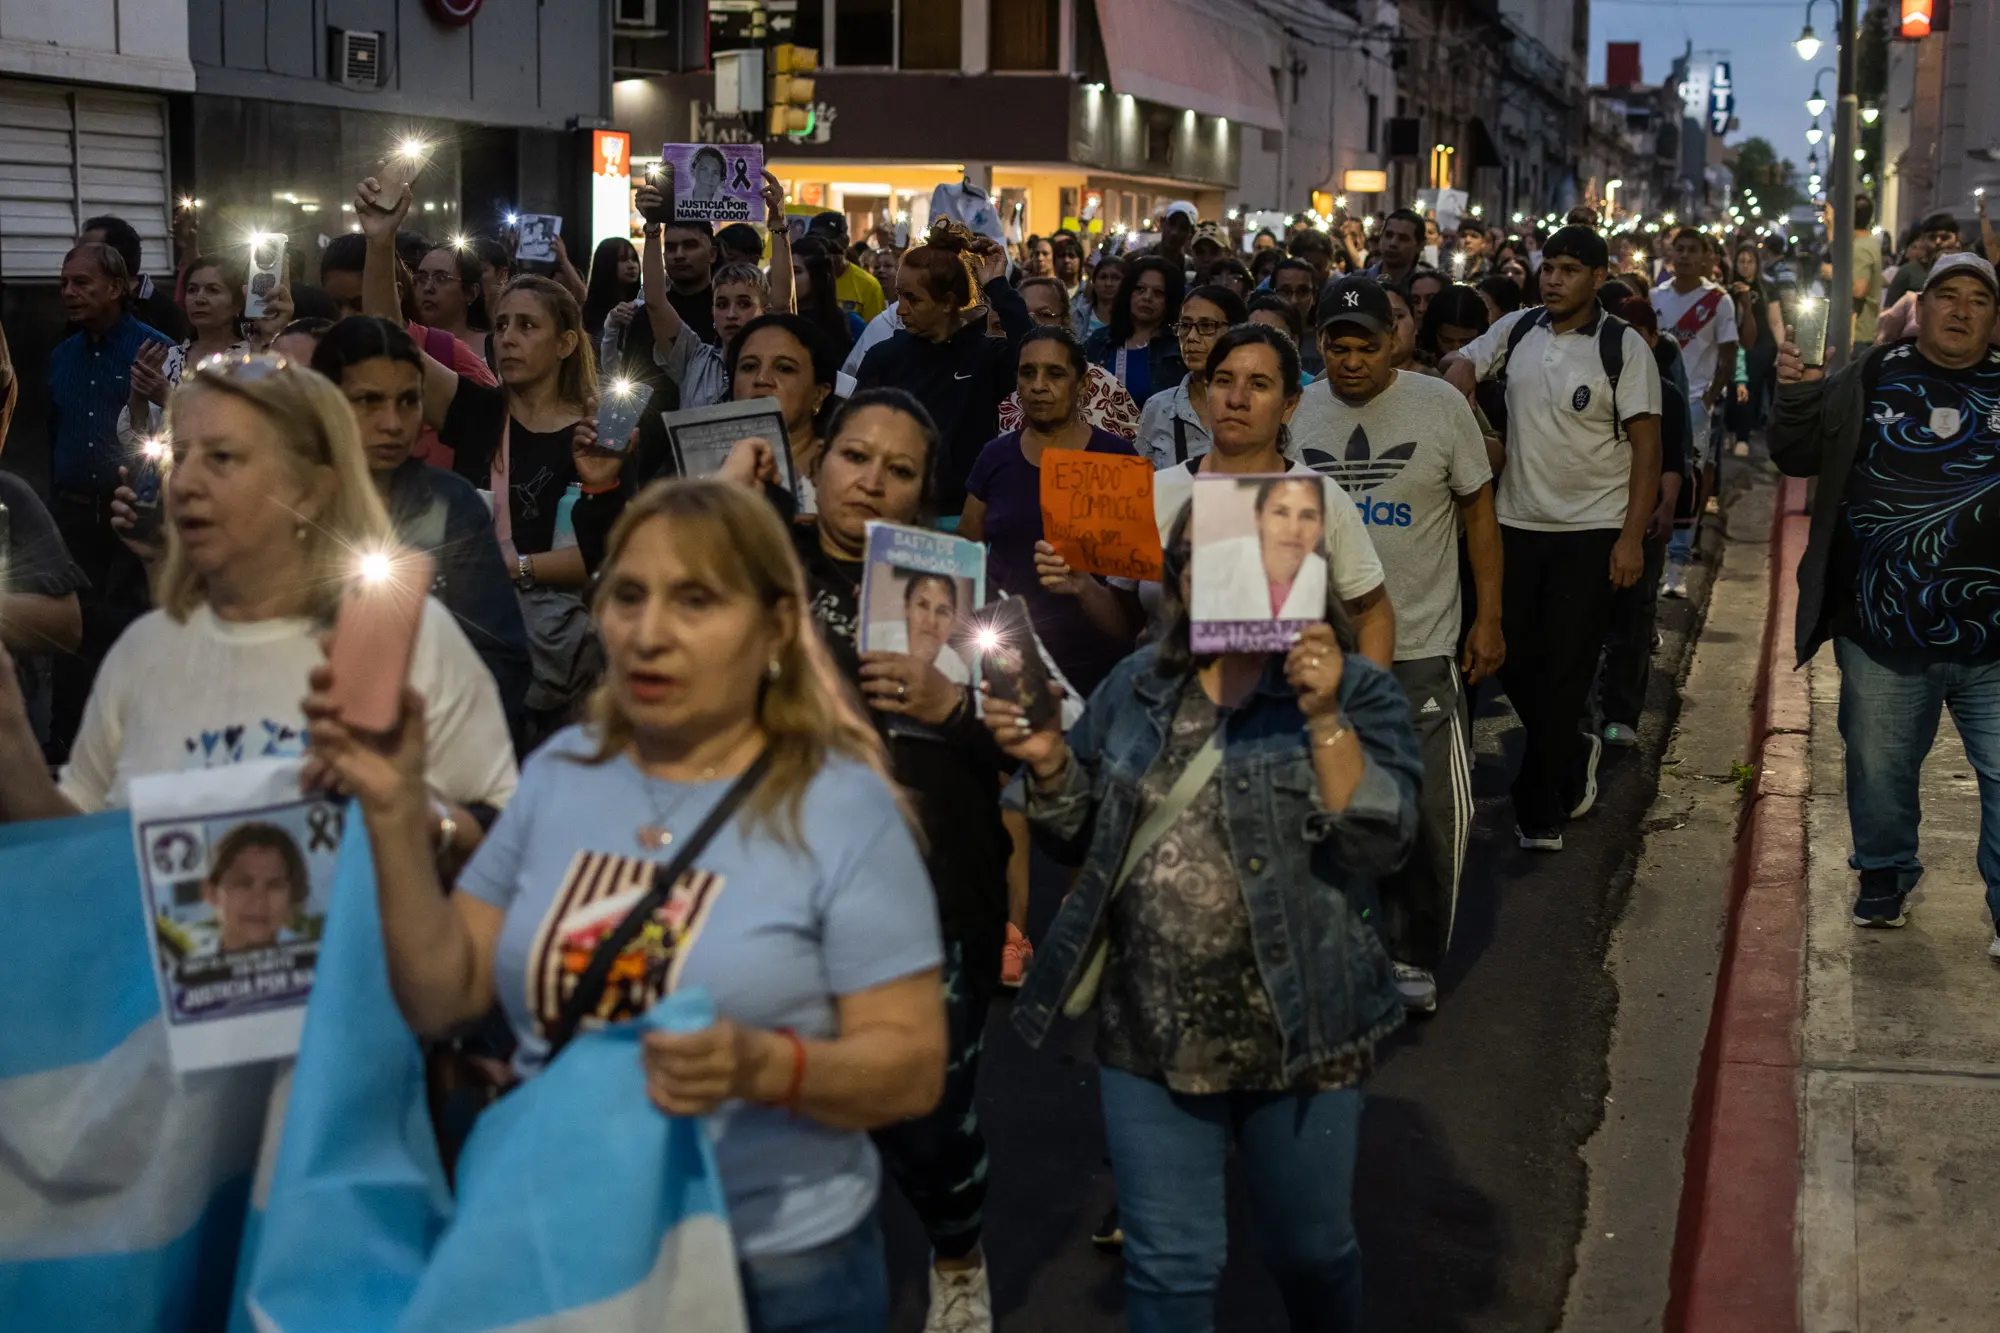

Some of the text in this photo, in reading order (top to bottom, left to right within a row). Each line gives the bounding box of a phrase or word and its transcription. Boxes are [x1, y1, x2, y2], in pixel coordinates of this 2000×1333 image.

[1712, 64, 1731, 133] LT7
[678, 199, 748, 211] JUSTICIA POR
[676, 208, 750, 220] NANCY GODOY
[1355, 495, 1412, 527] das
[1196, 621, 1278, 638] JUSTICIA
